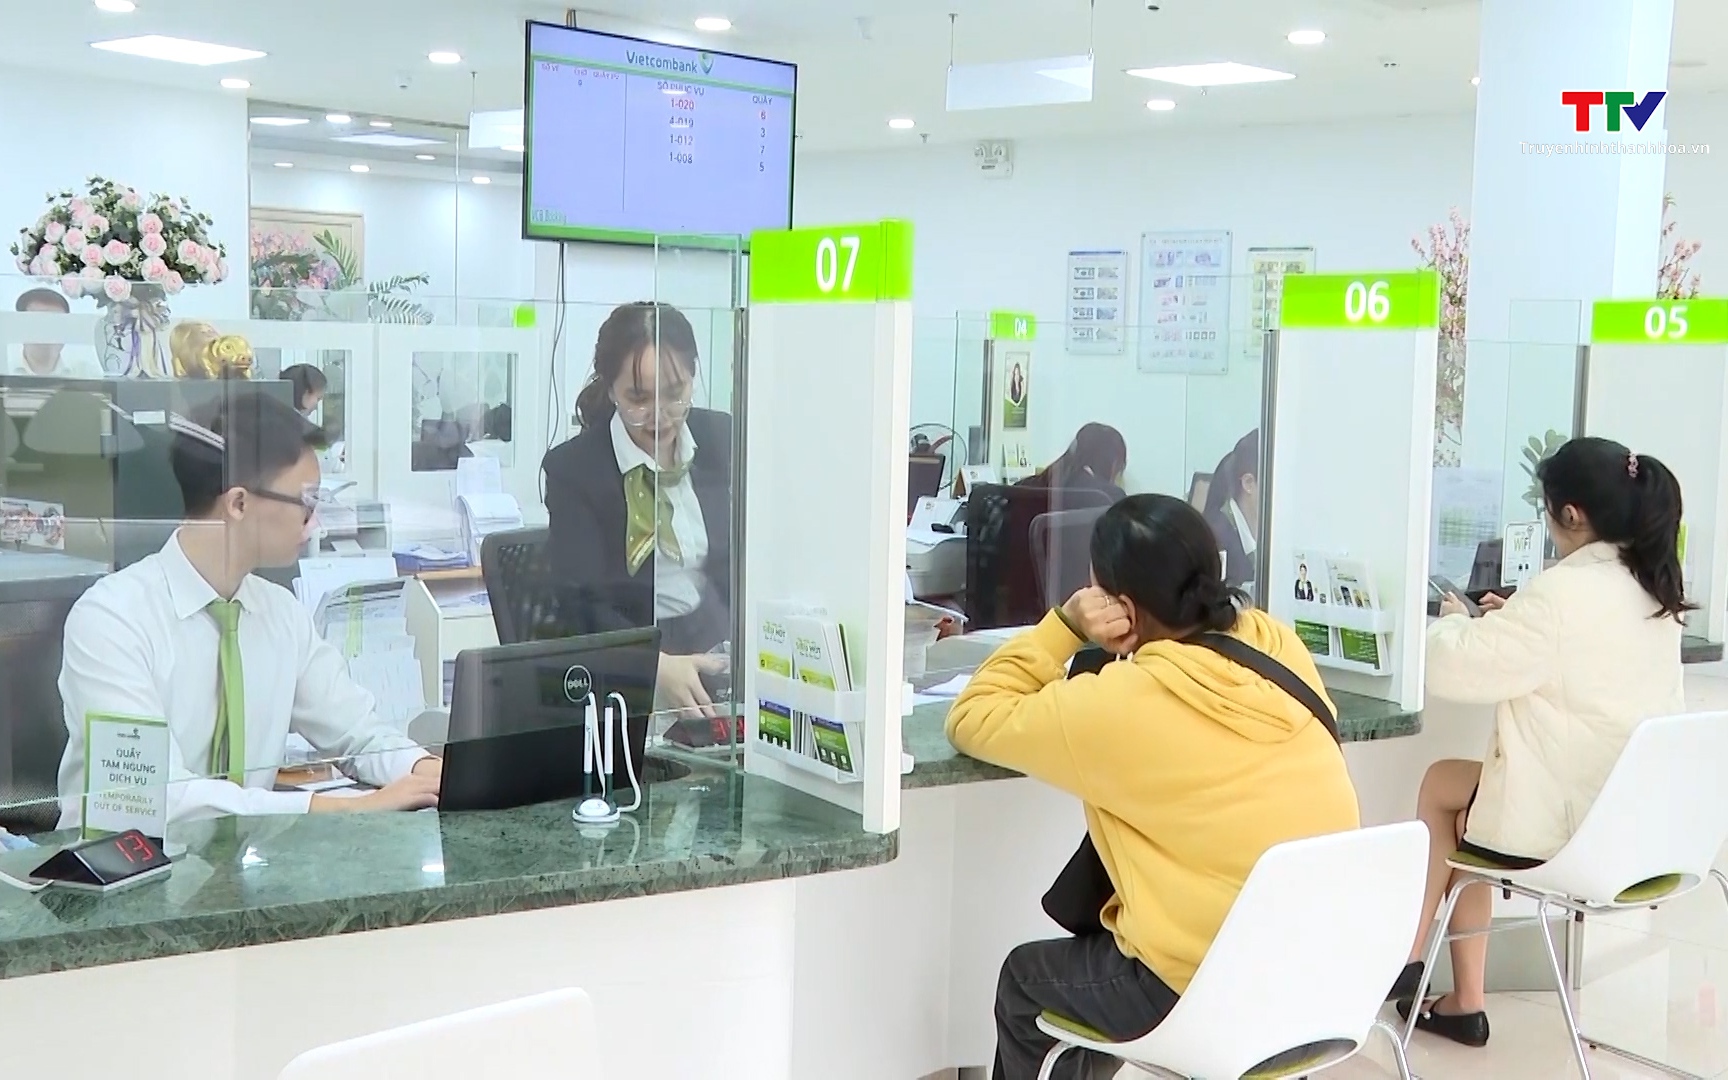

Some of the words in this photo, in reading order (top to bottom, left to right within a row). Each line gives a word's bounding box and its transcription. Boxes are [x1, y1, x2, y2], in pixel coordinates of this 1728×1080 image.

[626, 49, 698, 73] Vietcombank
[670, 98, 695, 111] 1-020
[670, 134, 694, 146] 1-012
[760, 127, 766, 138] 3
[760, 145, 766, 154] 7
[815, 236, 861, 293] 07
[1344, 280, 1390, 322] 06
[1014, 316, 1028, 338] 04
[1644, 305, 1689, 340] 05
[567, 677, 589, 690] DELL
[94, 801, 110, 811] OUT
[112, 803, 122, 812] OF
[125, 805, 157, 817] SERVICE
[115, 834, 153, 864] 13
